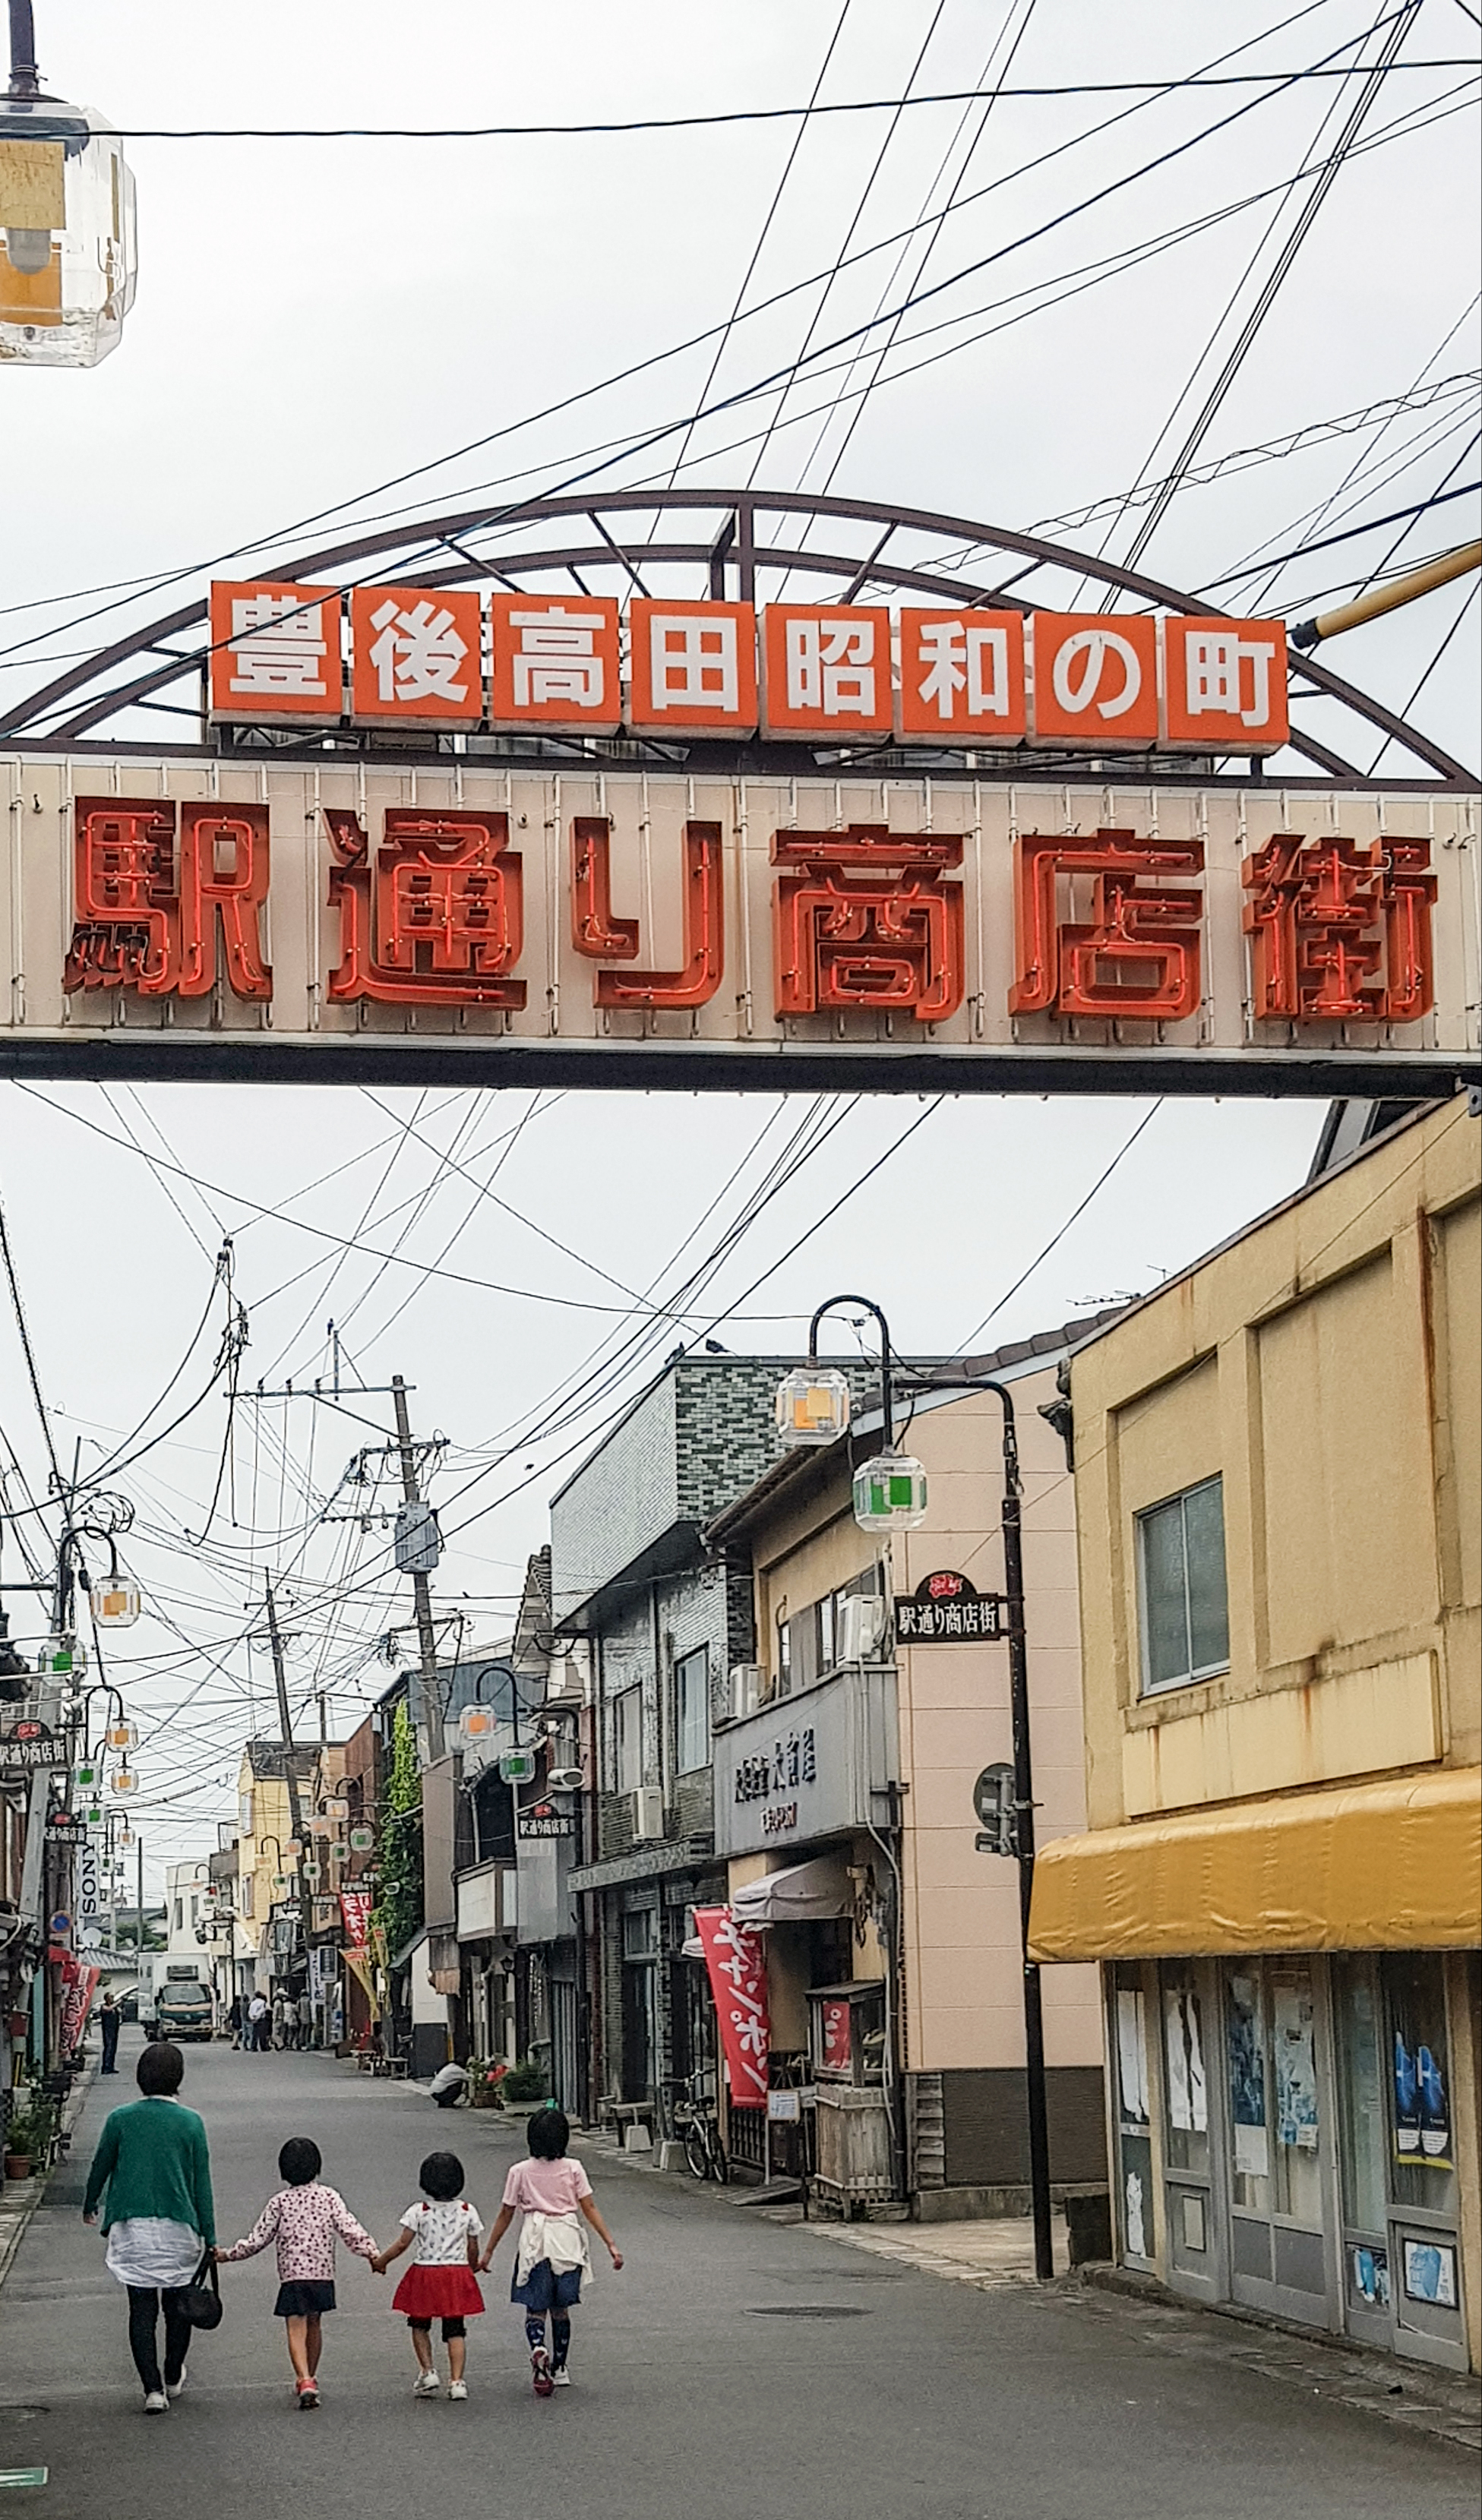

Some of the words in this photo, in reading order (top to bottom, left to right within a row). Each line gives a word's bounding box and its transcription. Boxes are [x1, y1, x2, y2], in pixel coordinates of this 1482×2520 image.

[229, 595, 1276, 727] 豊後高田昭和の町
[63, 796, 1438, 1024] 駅通り商店街
[899, 1601, 997, 1634] 駅通り商店街
[82, 1843, 96, 1913] SONY
